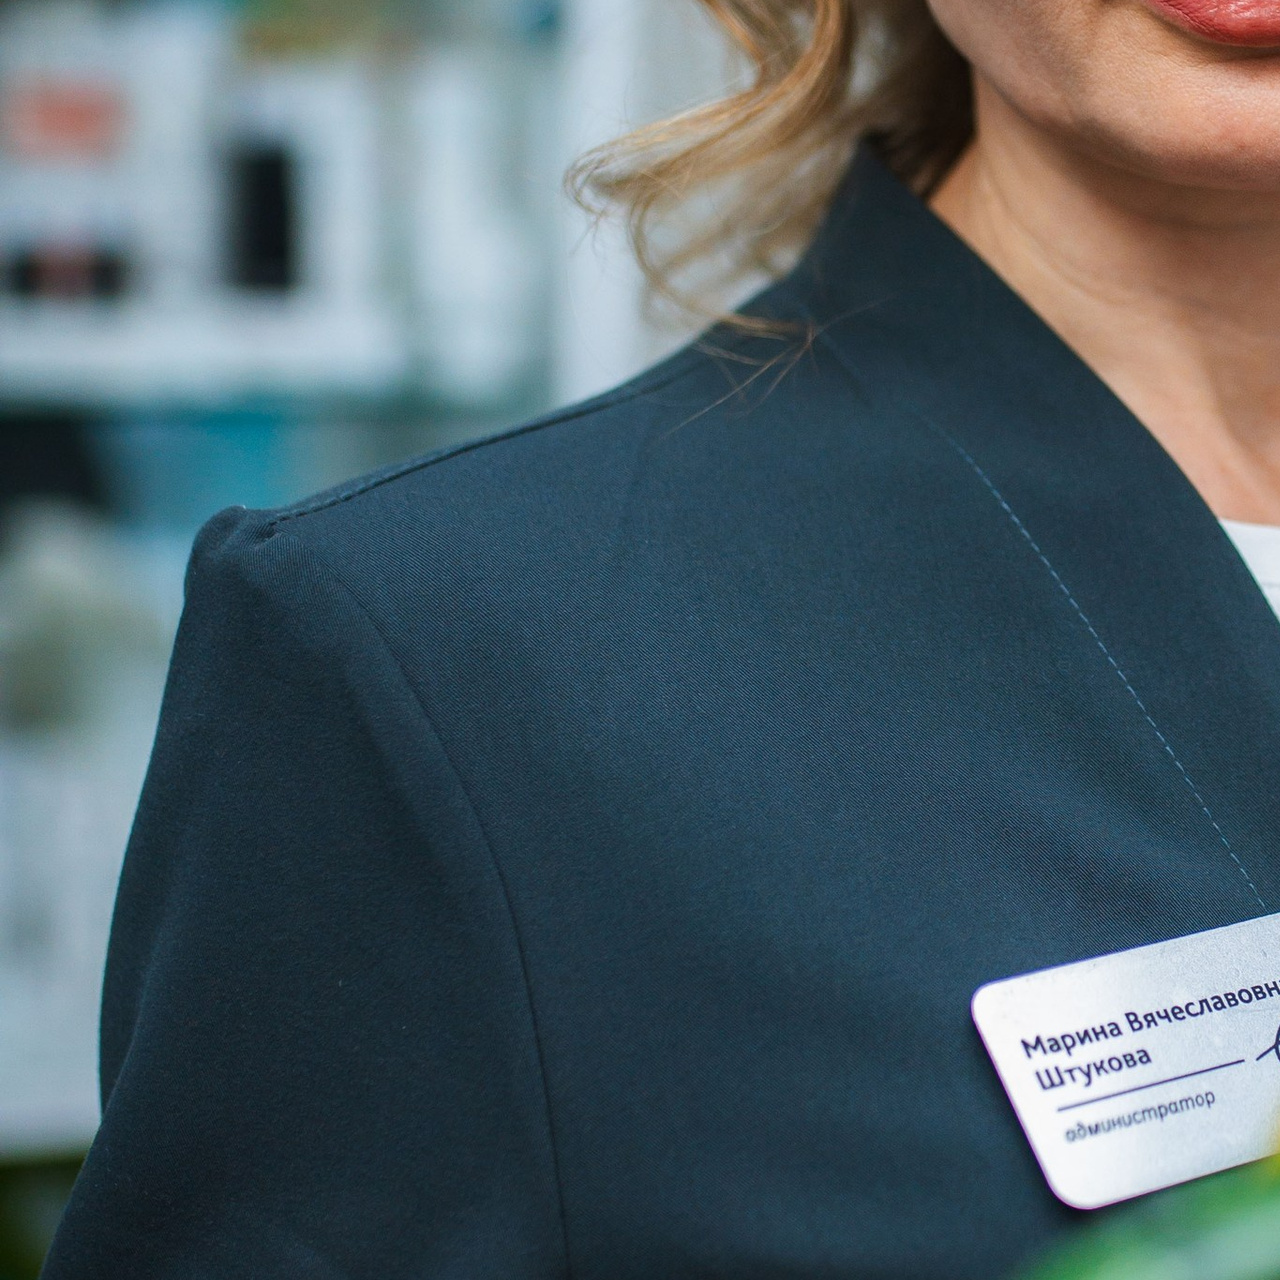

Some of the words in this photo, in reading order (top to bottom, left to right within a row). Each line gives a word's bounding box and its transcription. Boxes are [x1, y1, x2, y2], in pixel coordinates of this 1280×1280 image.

[1021, 1020, 1123, 1060] Марина
[1036, 1047, 1152, 1091] Штукова
[1065, 1090, 1216, 1143] администратор
